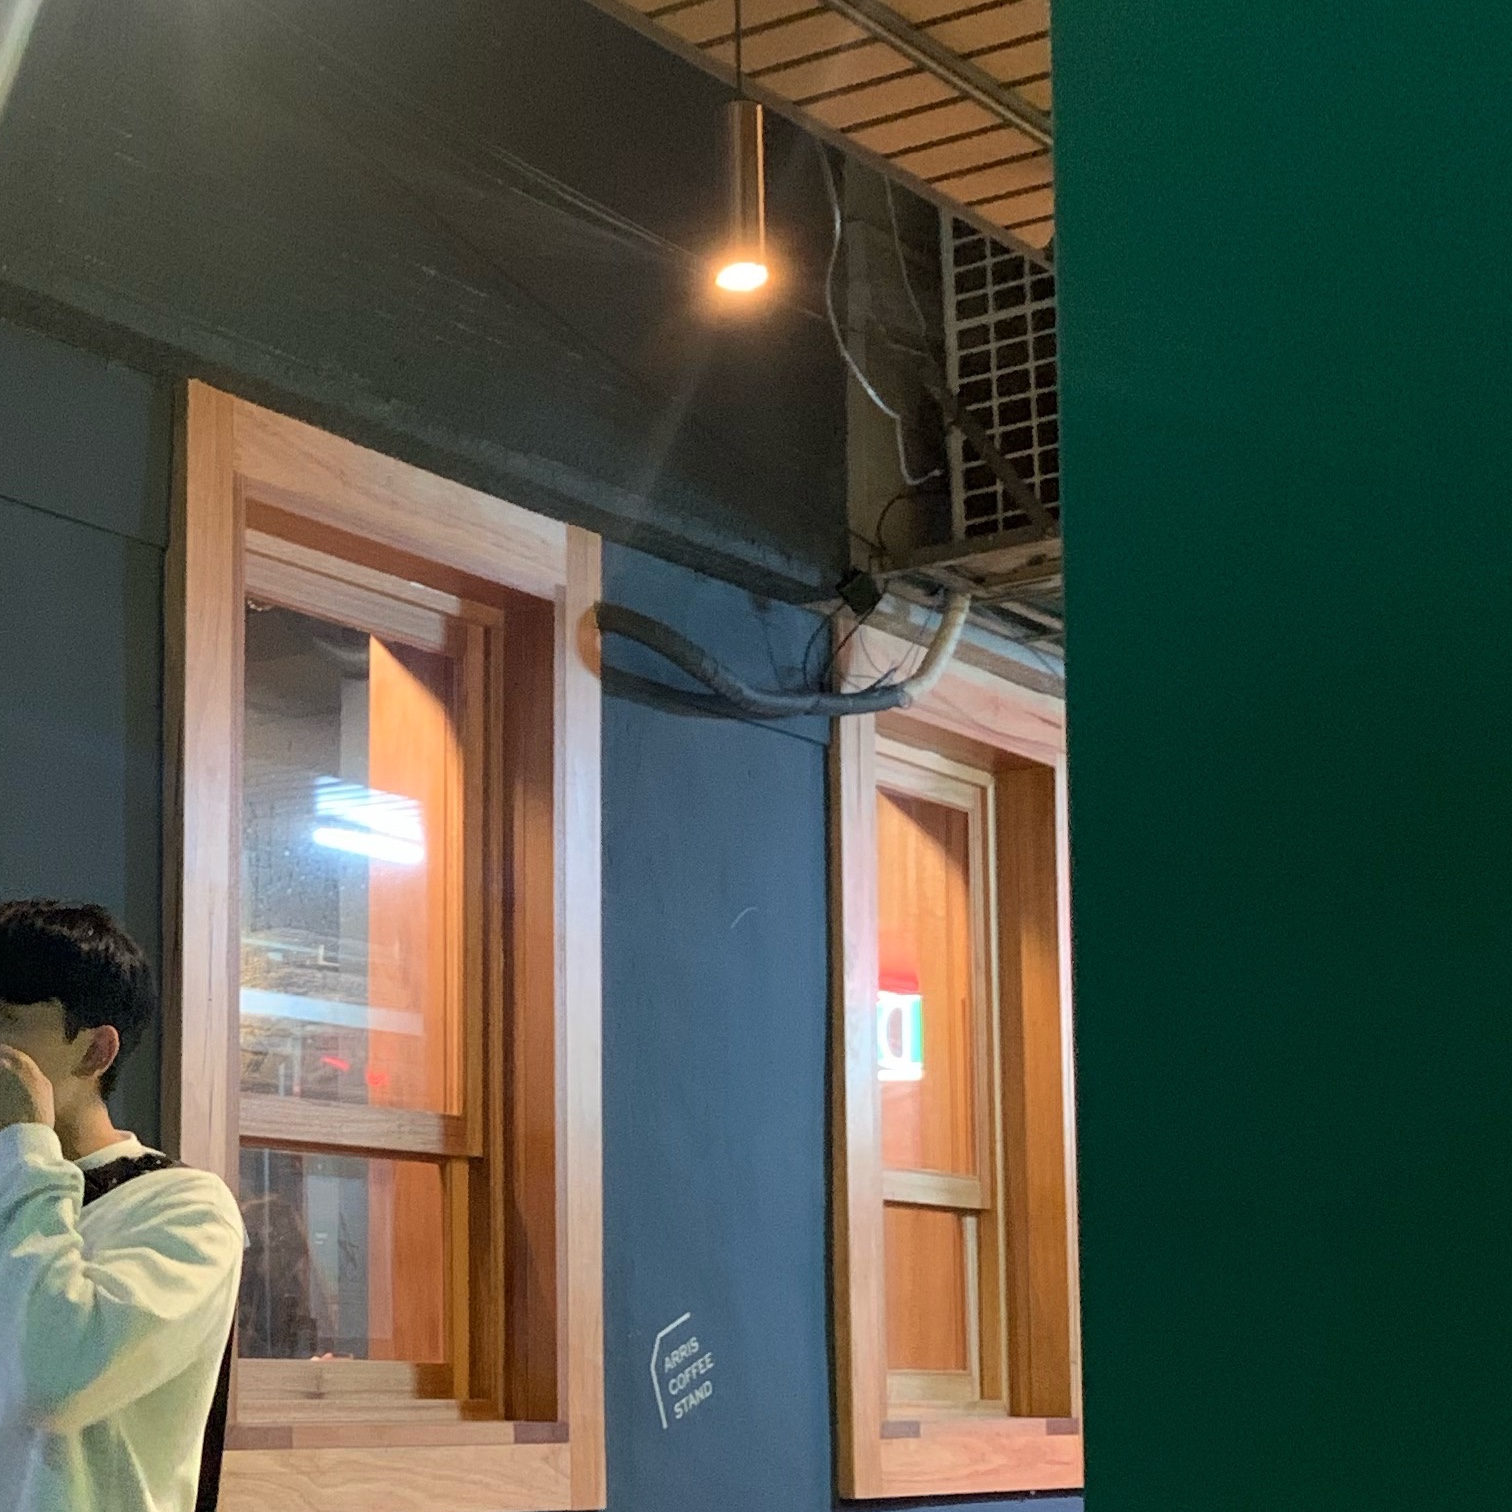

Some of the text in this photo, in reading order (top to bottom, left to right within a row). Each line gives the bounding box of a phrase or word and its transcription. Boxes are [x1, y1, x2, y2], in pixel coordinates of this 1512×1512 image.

[664, 1336, 699, 1373] ARRIS
[669, 1351, 715, 1395] COFFEE
[674, 1380, 713, 1419] STAND
